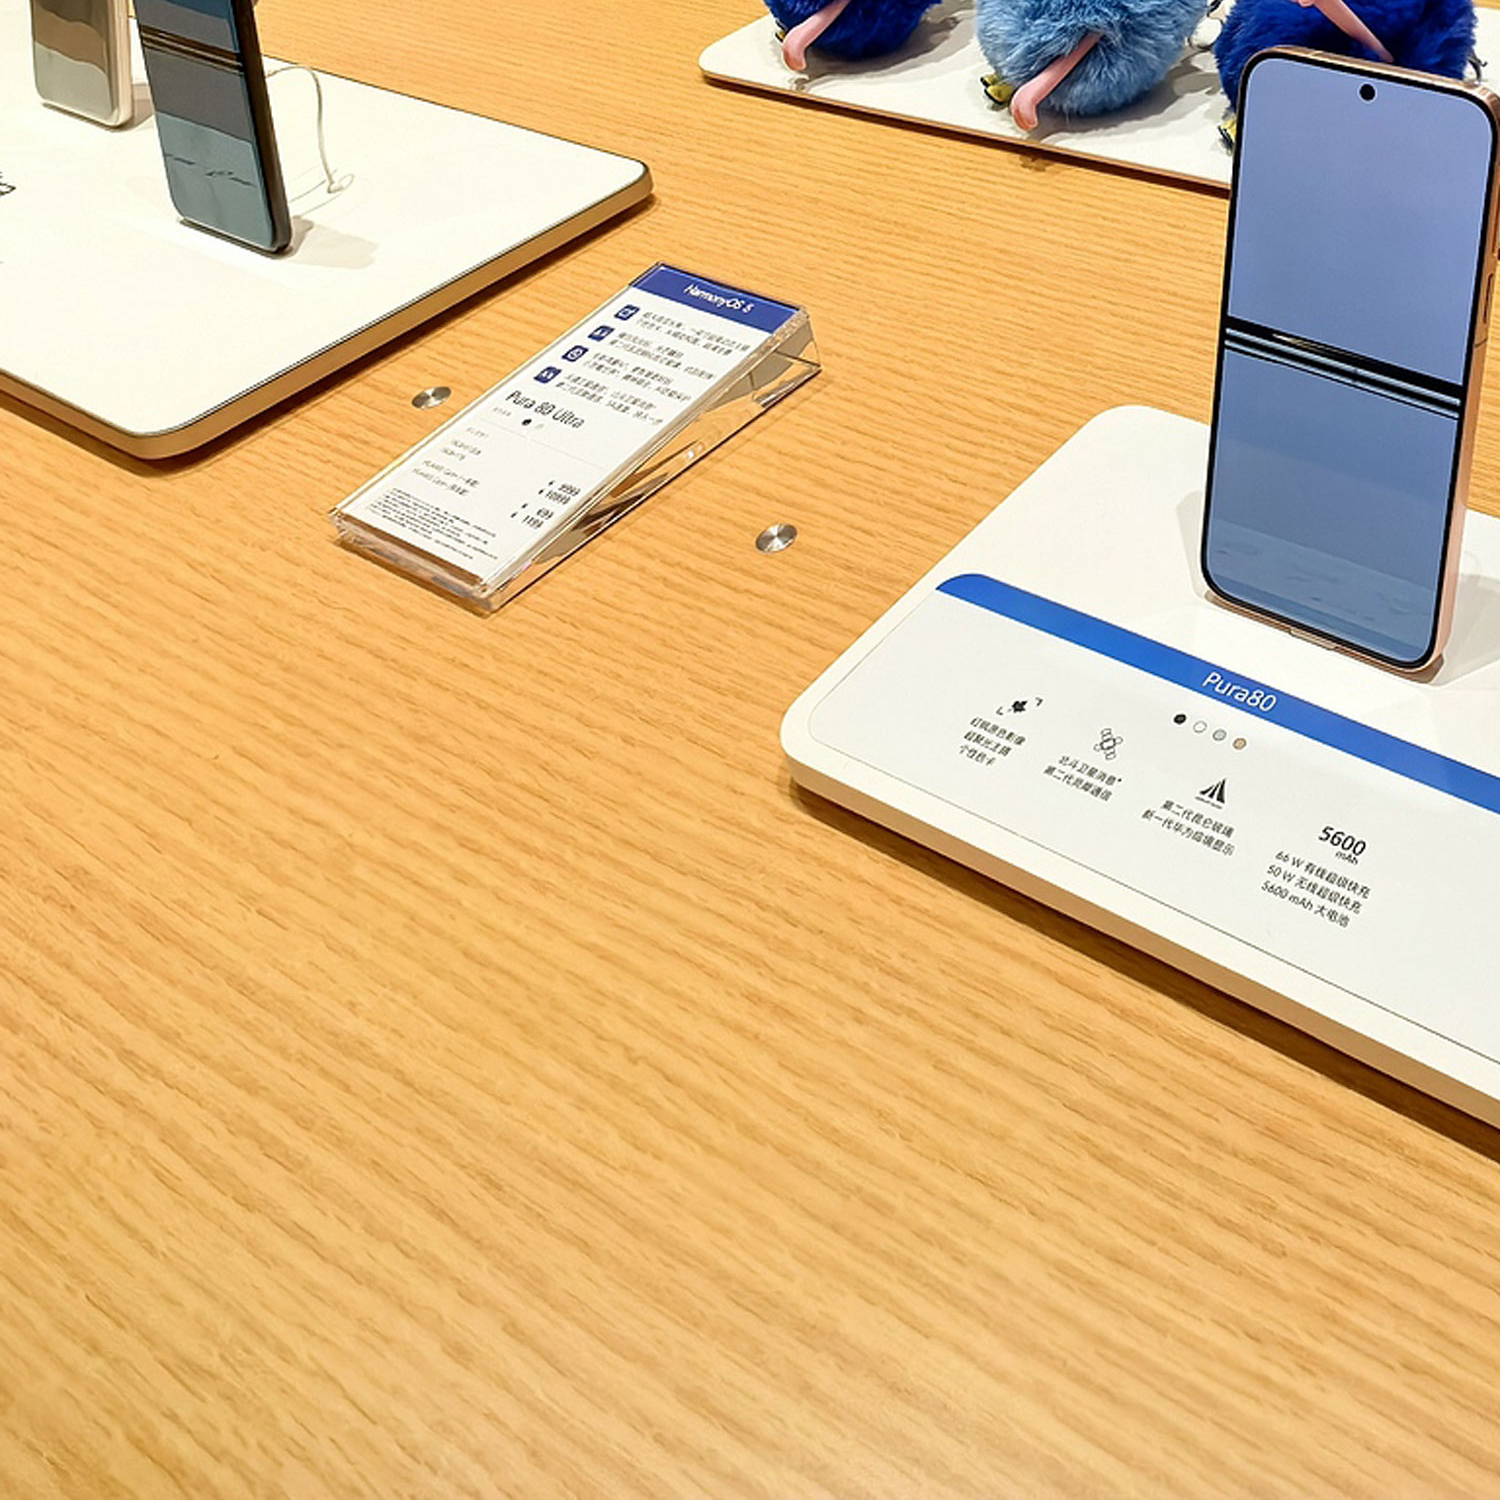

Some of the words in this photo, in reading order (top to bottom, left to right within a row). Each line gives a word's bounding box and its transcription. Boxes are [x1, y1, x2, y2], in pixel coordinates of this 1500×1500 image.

[683, 283, 745, 310] HarmonyOS
[505, 390, 536, 409] Pura
[534, 401, 556, 416] 80
[552, 407, 585, 429] Ultra
[1201, 671, 1277, 712] Pura80
[1318, 825, 1367, 856] 5600
[1275, 851, 1290, 863] 66
[1291, 856, 1305, 868] W
[1335, 851, 1359, 866] mAh
[1266, 864, 1282, 878] 50
[1282, 870, 1296, 884] W
[1261, 880, 1290, 900] 5600
[1288, 894, 1314, 912] mAh
[1313, 904, 1351, 929] 大电池
